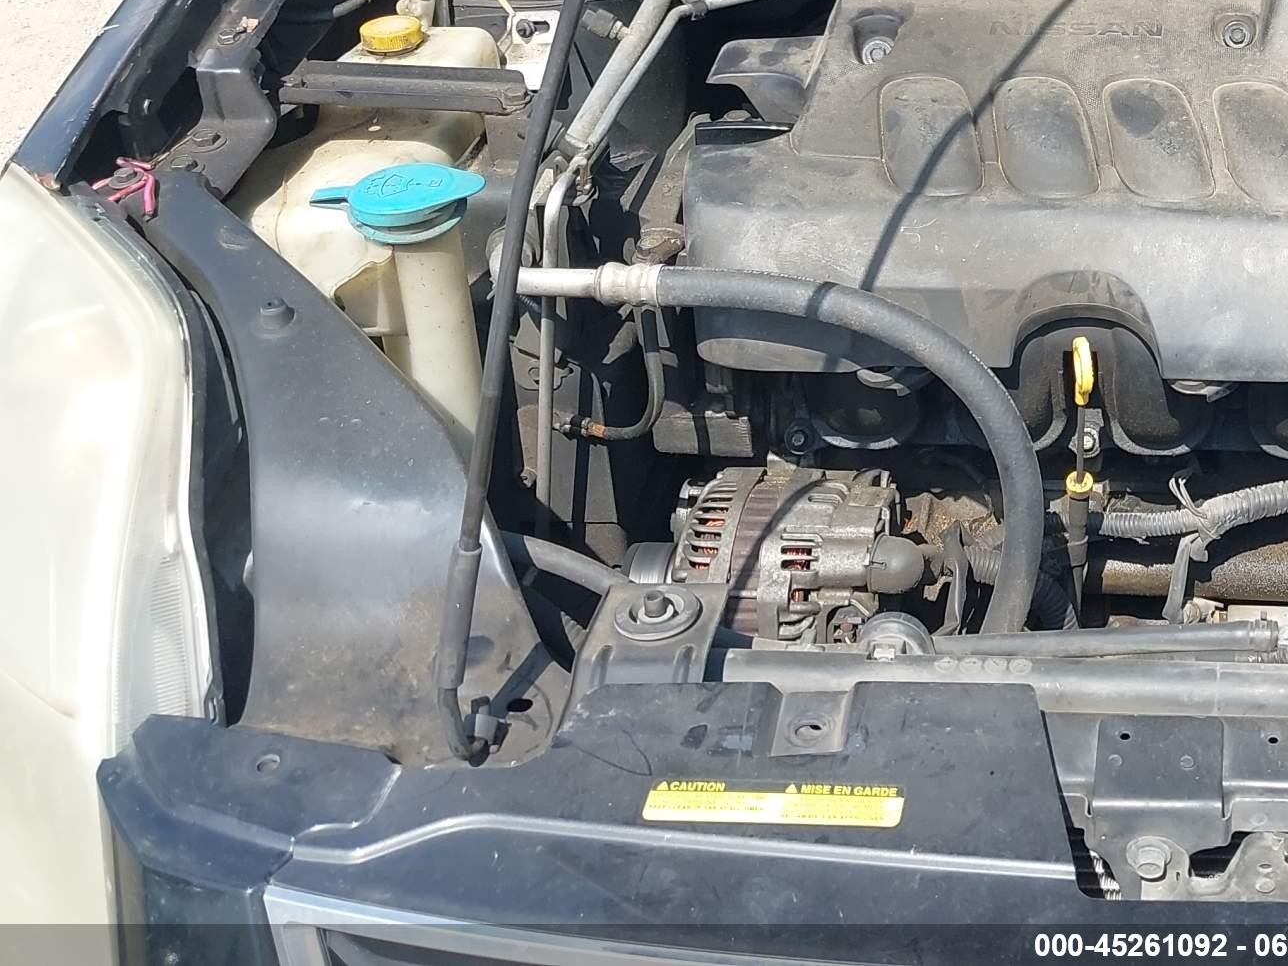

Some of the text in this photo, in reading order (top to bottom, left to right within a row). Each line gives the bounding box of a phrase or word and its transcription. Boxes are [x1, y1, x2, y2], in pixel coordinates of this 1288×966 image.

[989, 20, 1164, 38] NISSAN
[669, 781, 726, 791] CAUTION
[800, 784, 898, 797] MISE EN GARDE
